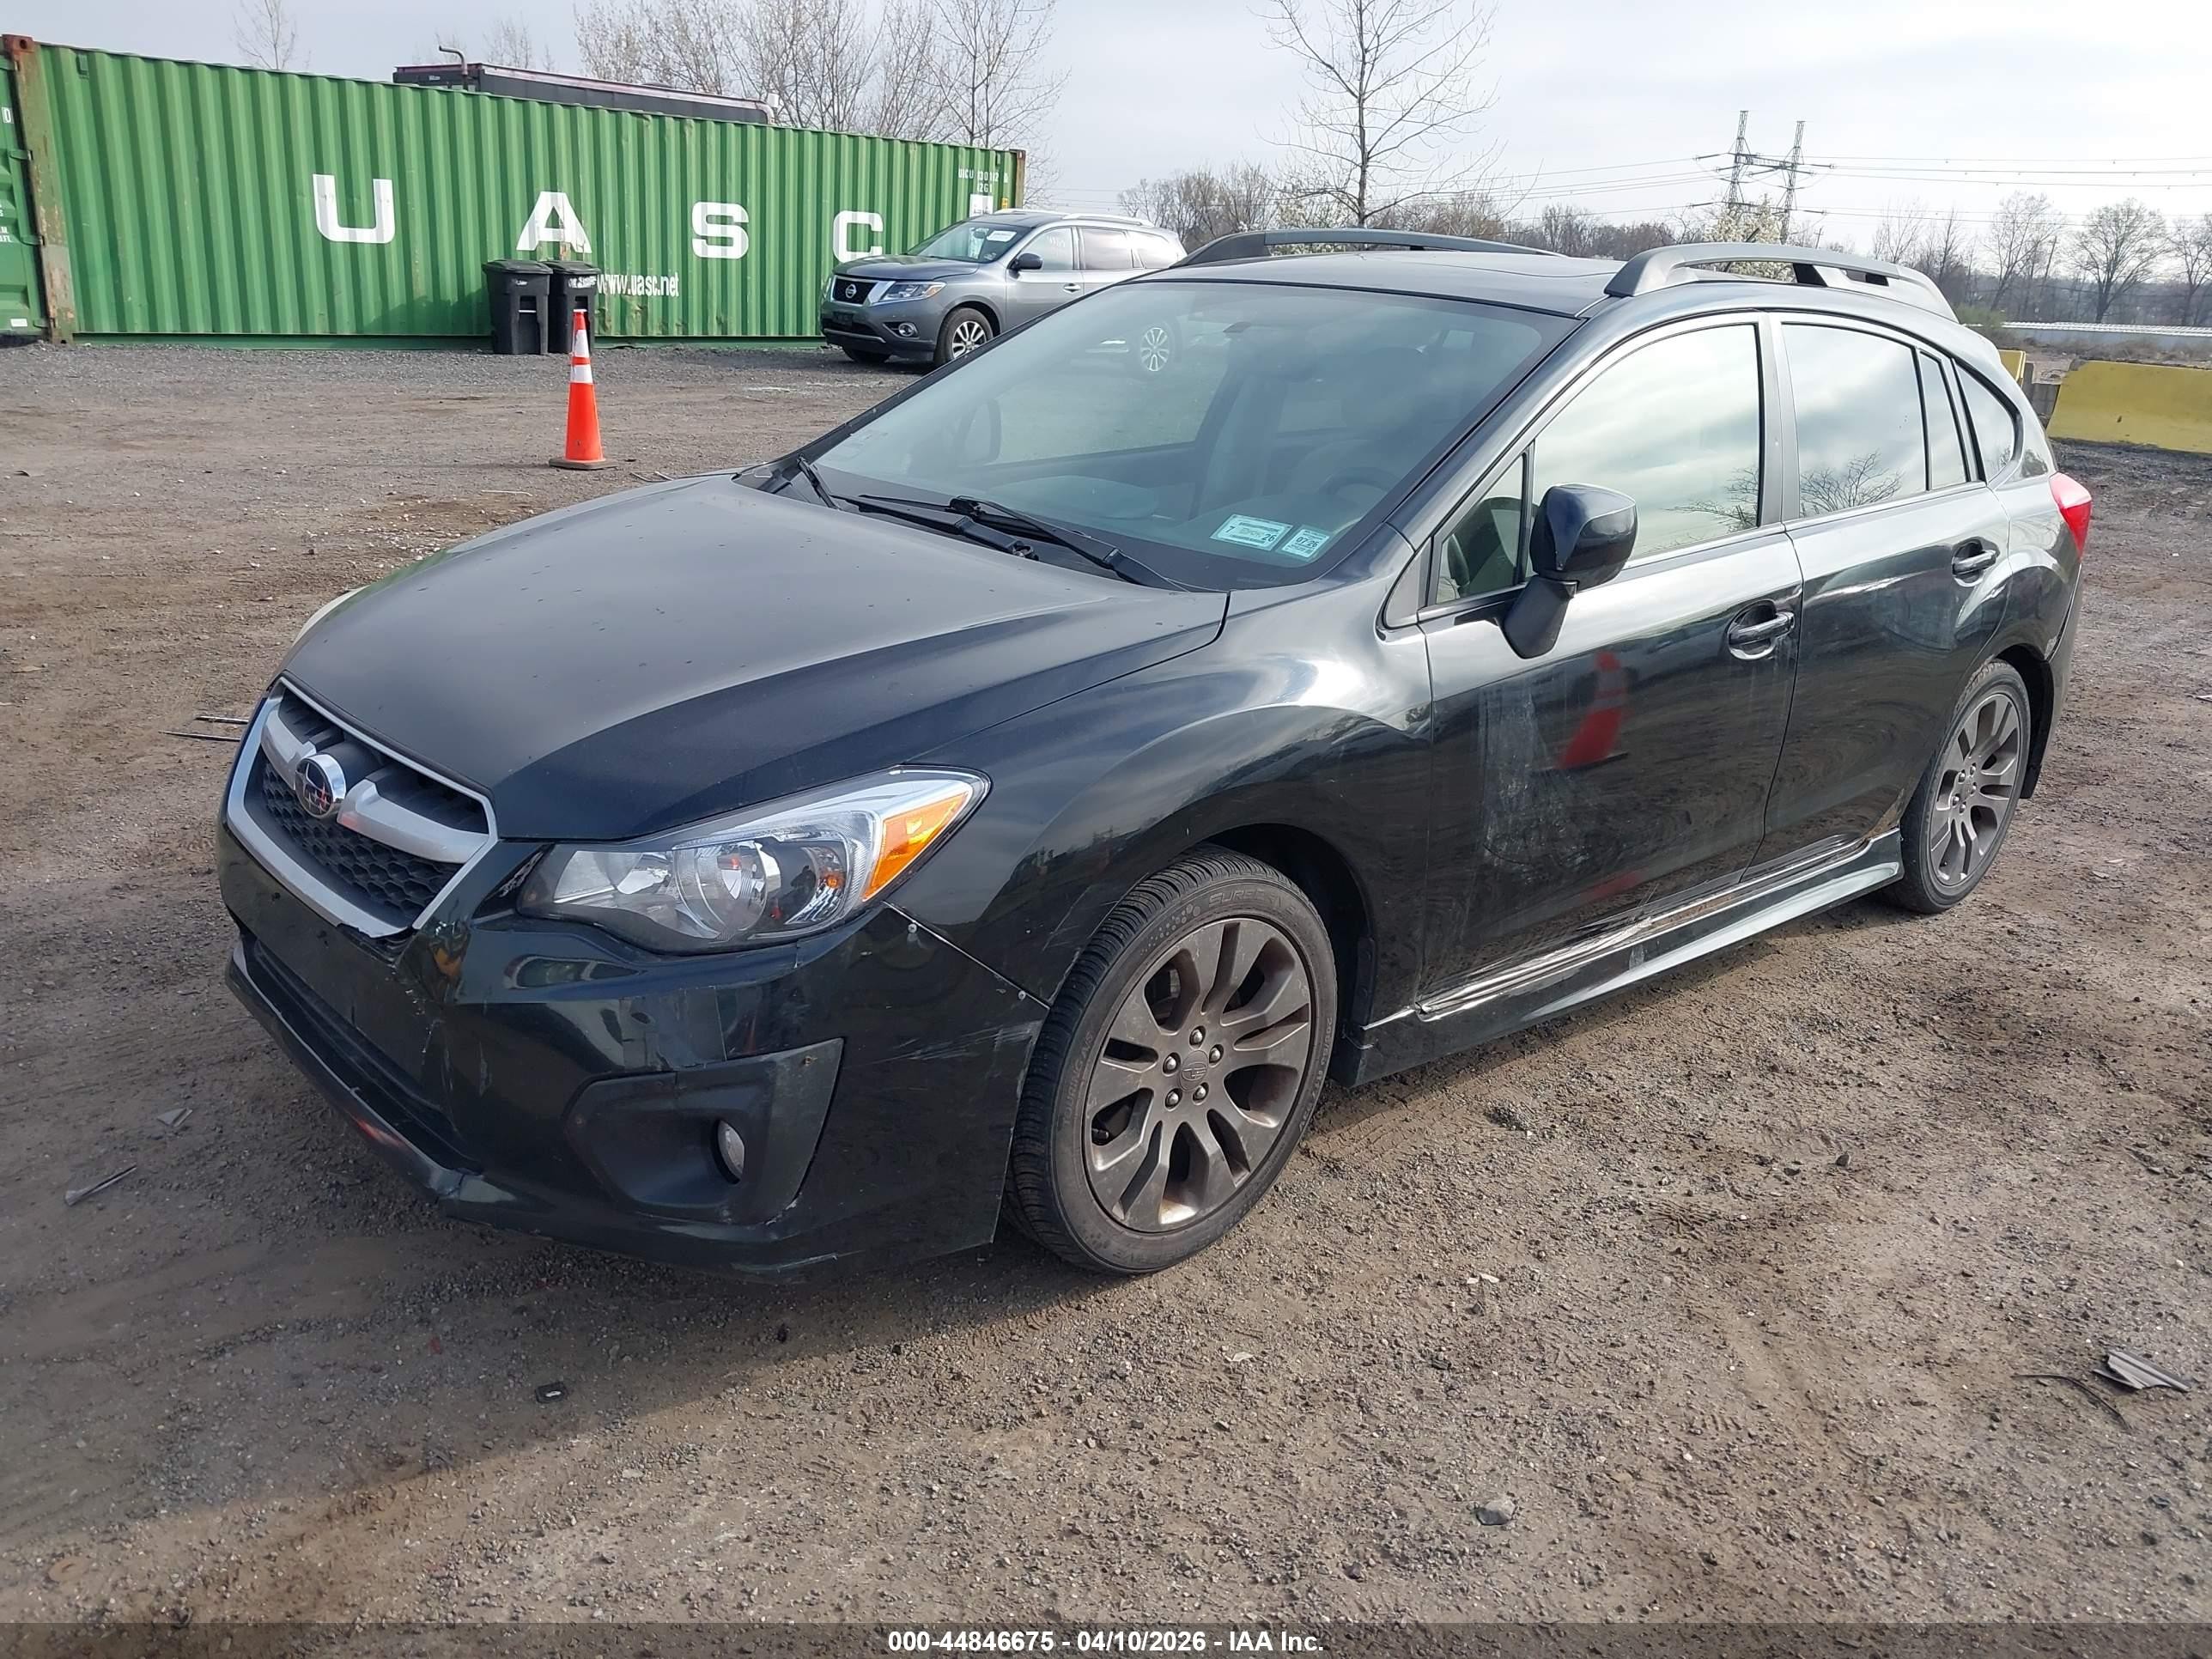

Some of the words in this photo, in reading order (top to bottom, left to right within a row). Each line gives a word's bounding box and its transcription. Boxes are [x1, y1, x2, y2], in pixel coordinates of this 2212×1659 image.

[597, 271, 679, 297] www.uasc.net
[1261, 533, 1277, 542] 26
[1062, 1058, 1083, 1127] TOURING
